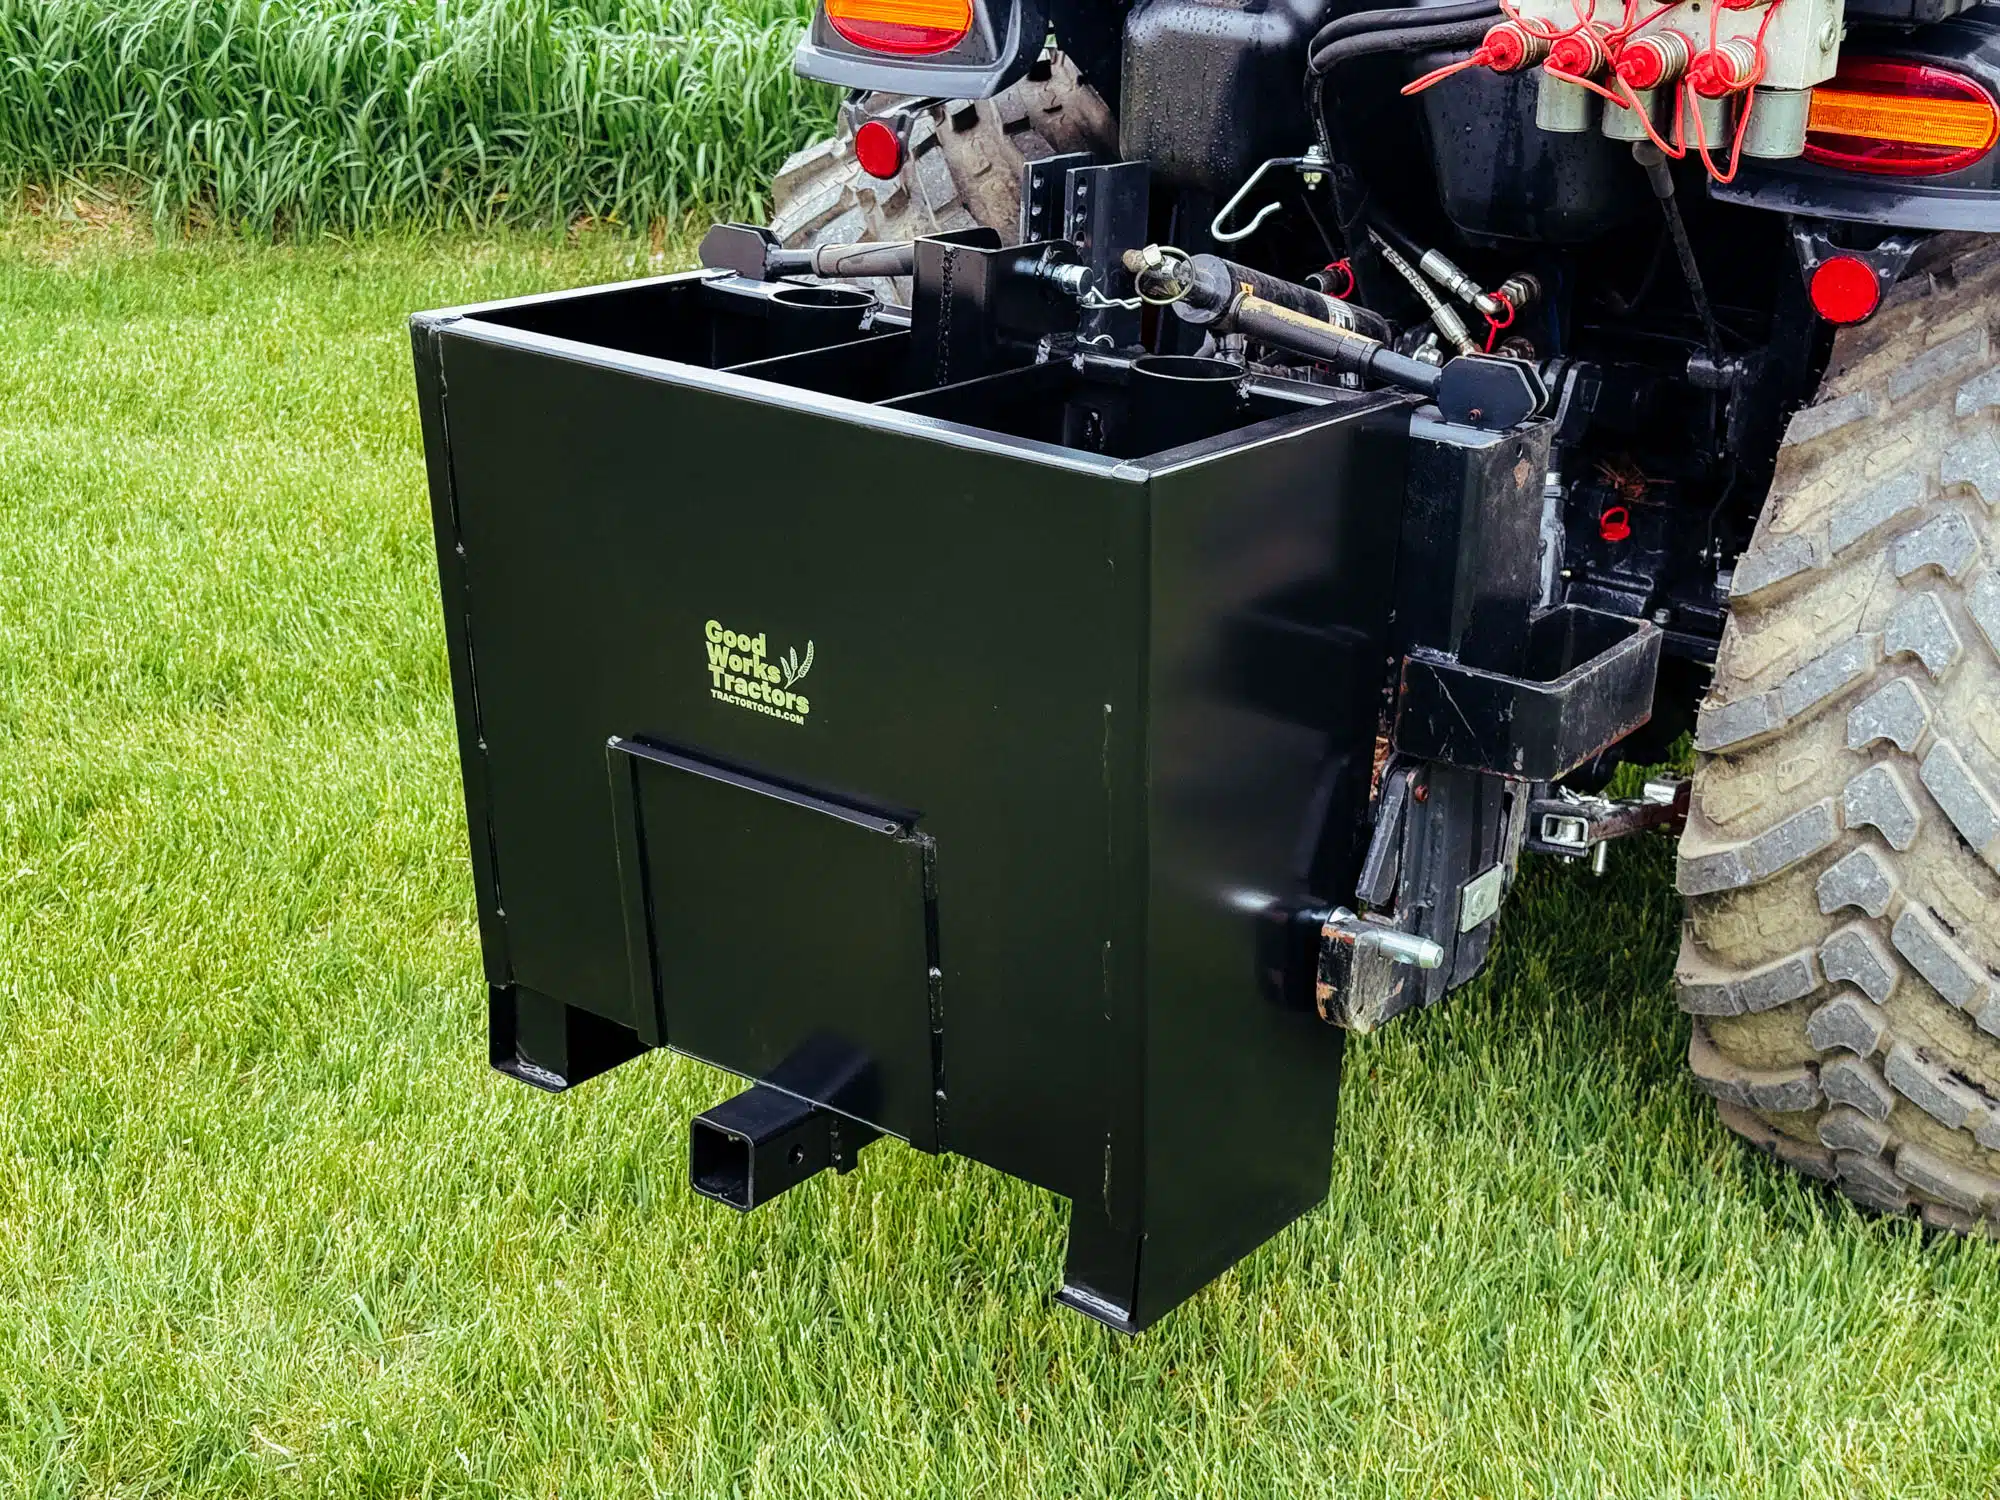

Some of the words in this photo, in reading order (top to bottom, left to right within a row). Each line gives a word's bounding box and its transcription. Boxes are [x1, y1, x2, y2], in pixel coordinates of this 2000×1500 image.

[705, 620, 766, 657] Good
[705, 641, 781, 683] Works
[708, 663, 809, 713] Tractors
[710, 688, 804, 725] TRACTORTOOLS.COM
